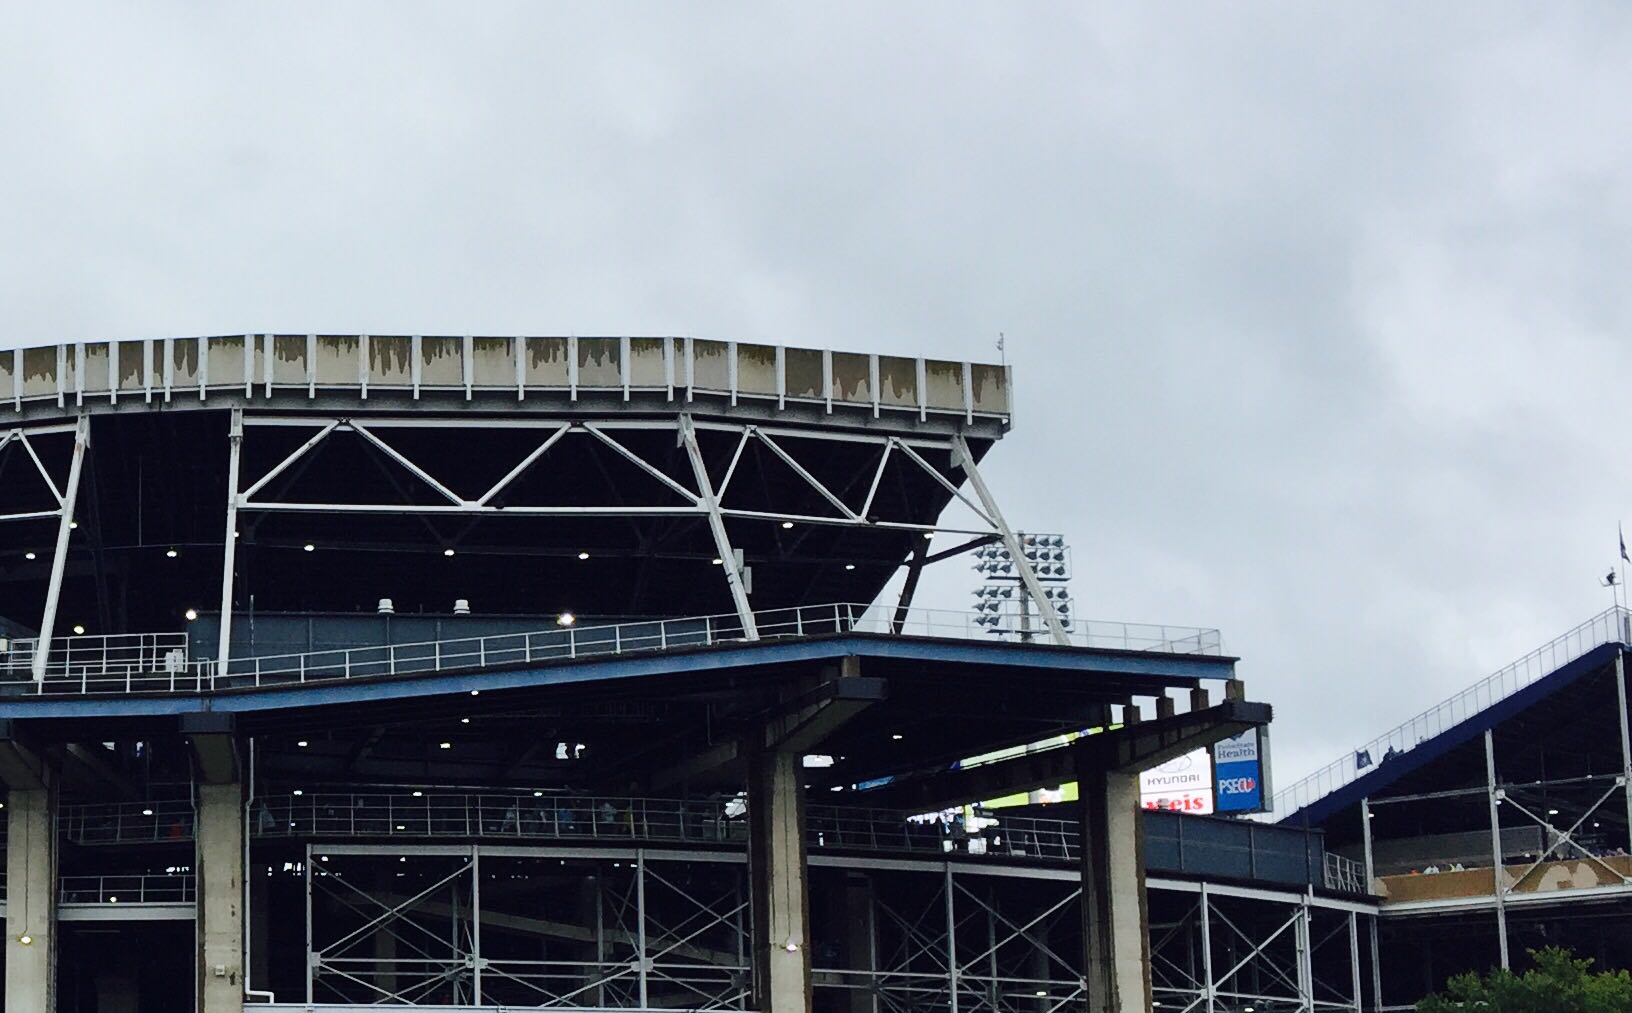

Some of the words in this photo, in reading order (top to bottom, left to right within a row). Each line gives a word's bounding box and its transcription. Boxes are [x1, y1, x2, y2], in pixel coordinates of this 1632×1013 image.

[1218, 747, 1255, 759] Health
[1147, 774, 1200, 786] HYUNDAI
[1219, 777, 1255, 795] PSECU
